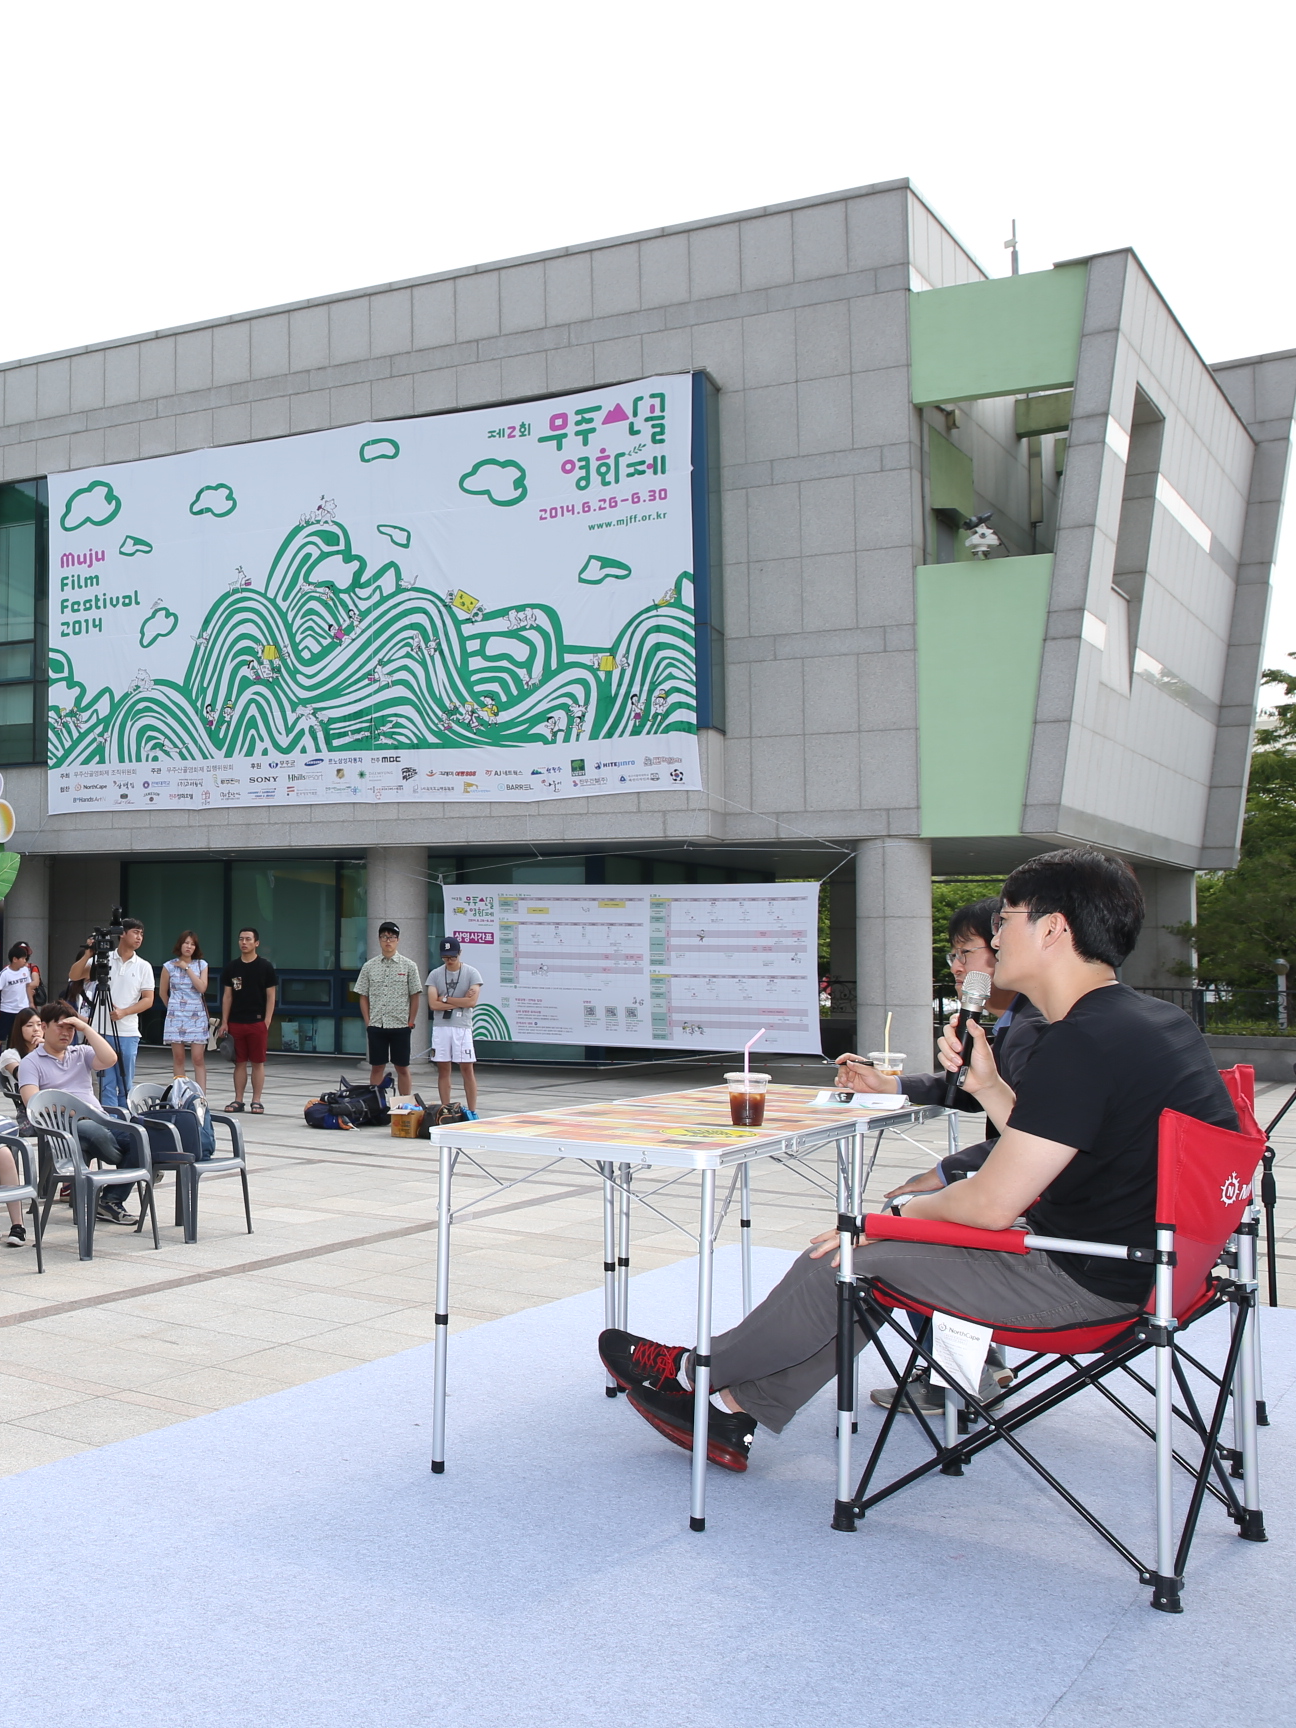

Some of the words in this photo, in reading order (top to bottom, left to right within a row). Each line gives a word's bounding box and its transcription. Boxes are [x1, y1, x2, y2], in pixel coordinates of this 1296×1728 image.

[487, 421, 531, 439] 제2회
[537, 392, 666, 452] 무주산골
[560, 447, 666, 491] 영화제
[588, 511, 667, 531] www.mjff.or.kr
[60, 548, 106, 571] Muju
[60, 571, 100, 590] Film
[60, 589, 141, 614] Festival
[60, 617, 103, 638] 2014
[249, 775, 279, 783] SONY
[454, 932, 494, 943] 상영시간표
[949, 1327, 980, 1342] NorthCape
